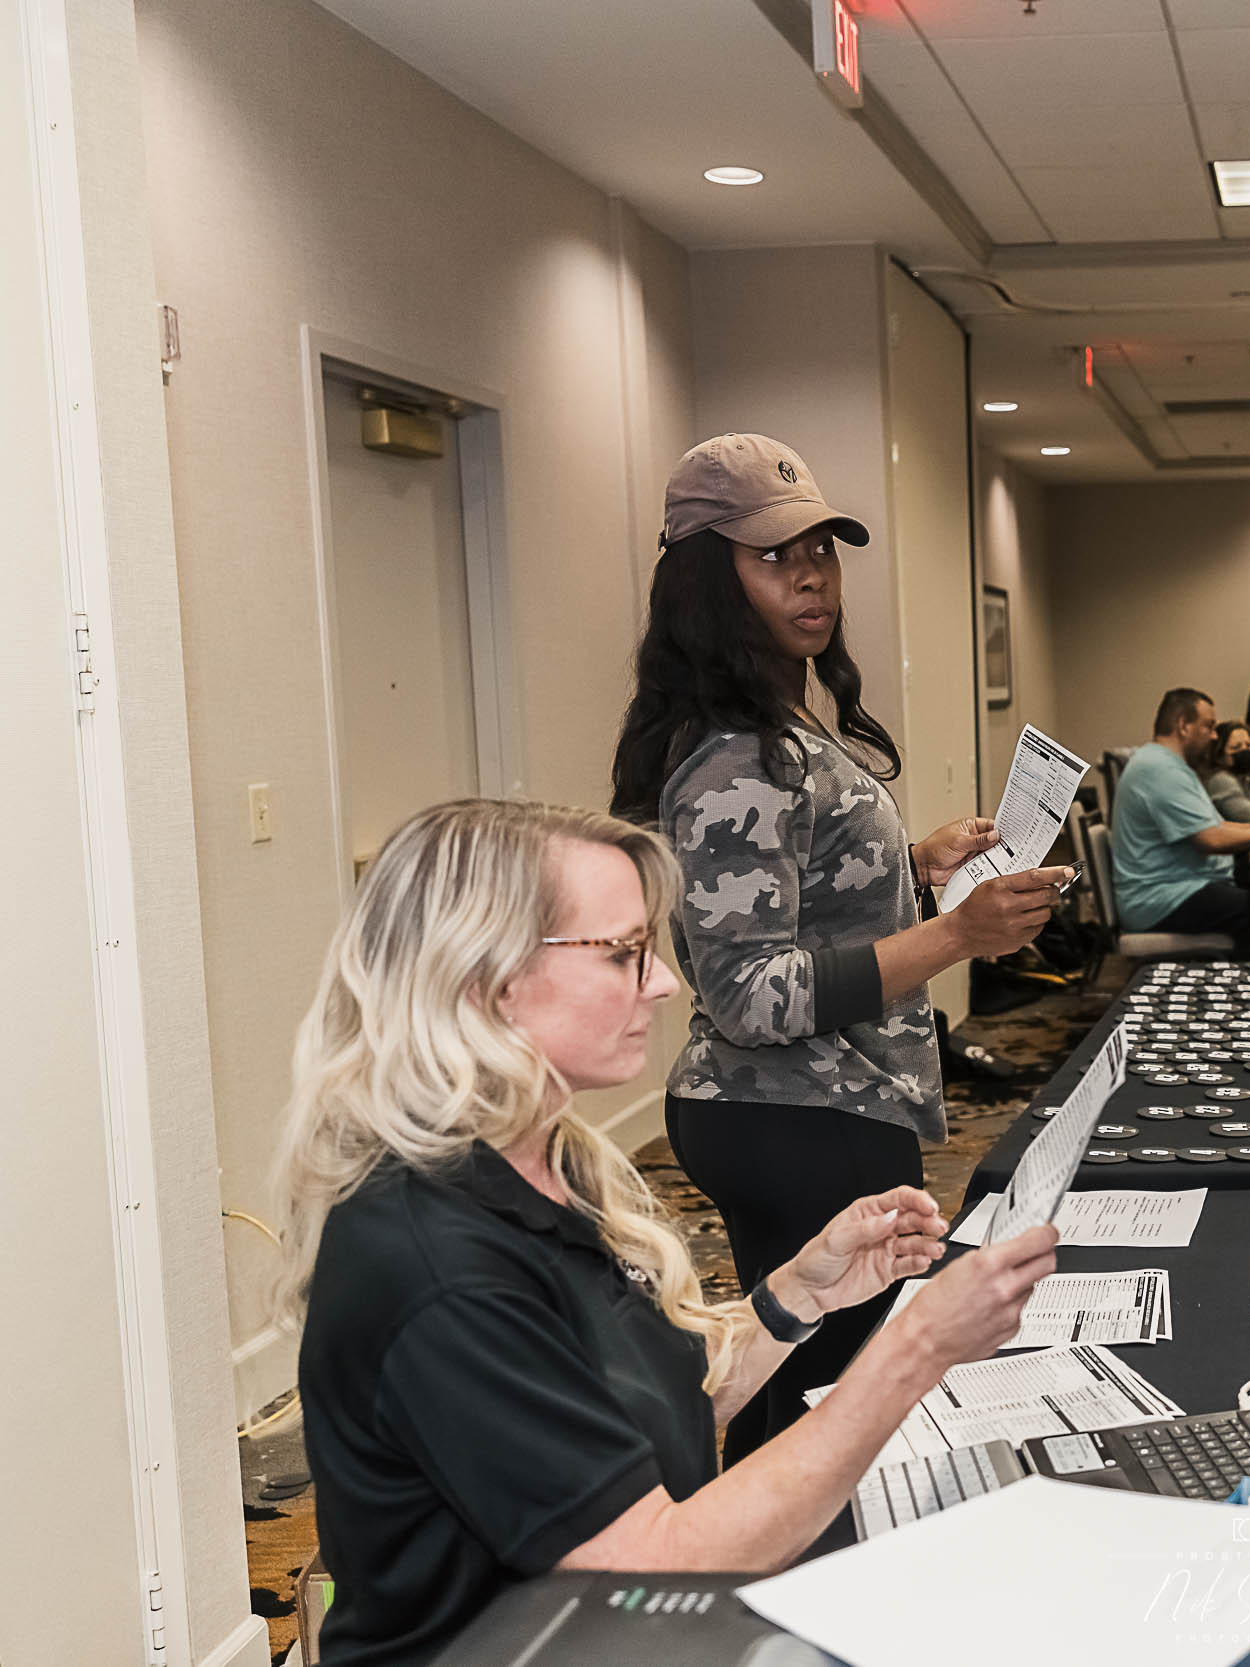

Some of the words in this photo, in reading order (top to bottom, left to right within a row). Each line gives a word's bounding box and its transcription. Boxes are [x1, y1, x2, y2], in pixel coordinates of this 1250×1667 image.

[1215, 1087, 1241, 1097] 33
[1148, 1106, 1175, 1116] 22
[1194, 1105, 1221, 1114] 23
[1097, 1125, 1125, 1134] 12
[1221, 1123, 1249, 1132] 14
